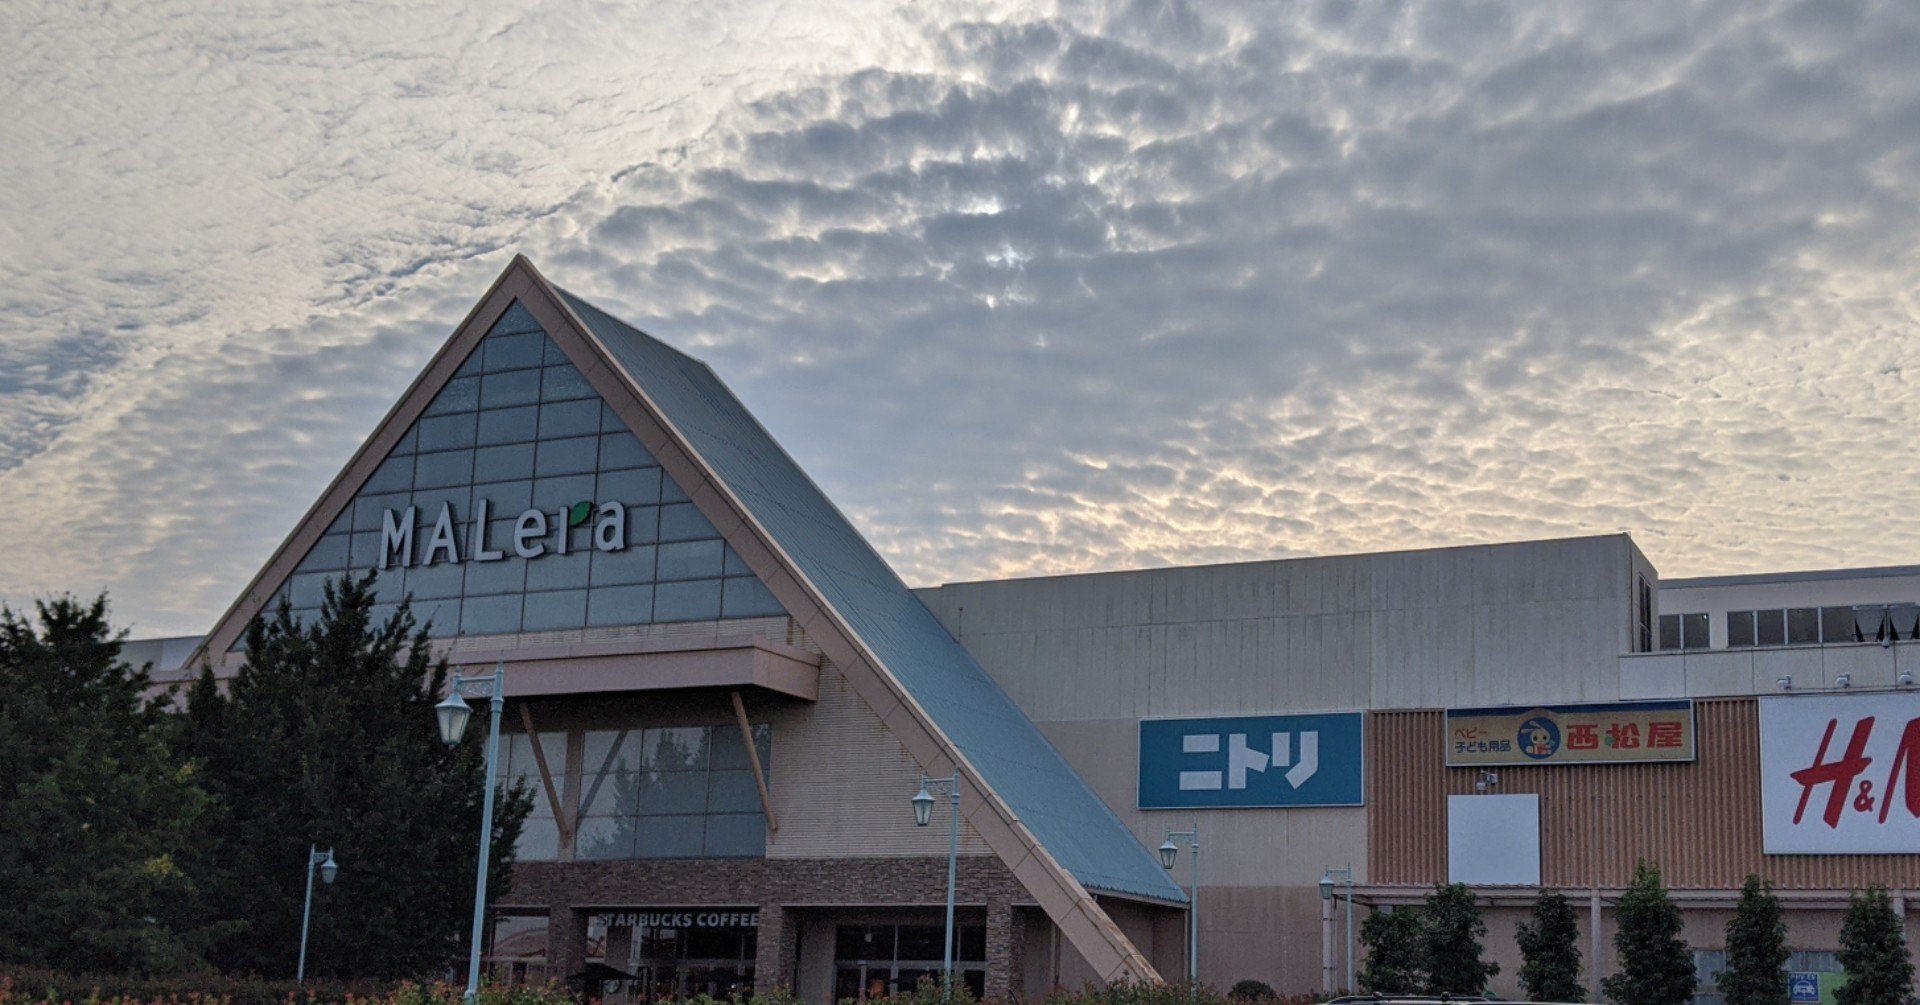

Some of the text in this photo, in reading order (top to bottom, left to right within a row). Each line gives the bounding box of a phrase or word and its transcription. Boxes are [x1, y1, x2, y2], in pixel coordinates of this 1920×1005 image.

[379, 498, 626, 570] MALera
[1455, 740, 1512, 754] 子ども用品
[1566, 721, 1684, 750] 西松屋
[1179, 730, 1319, 790] ニトリ
[599, 912, 759, 927] STARBUCKS COFFEE
